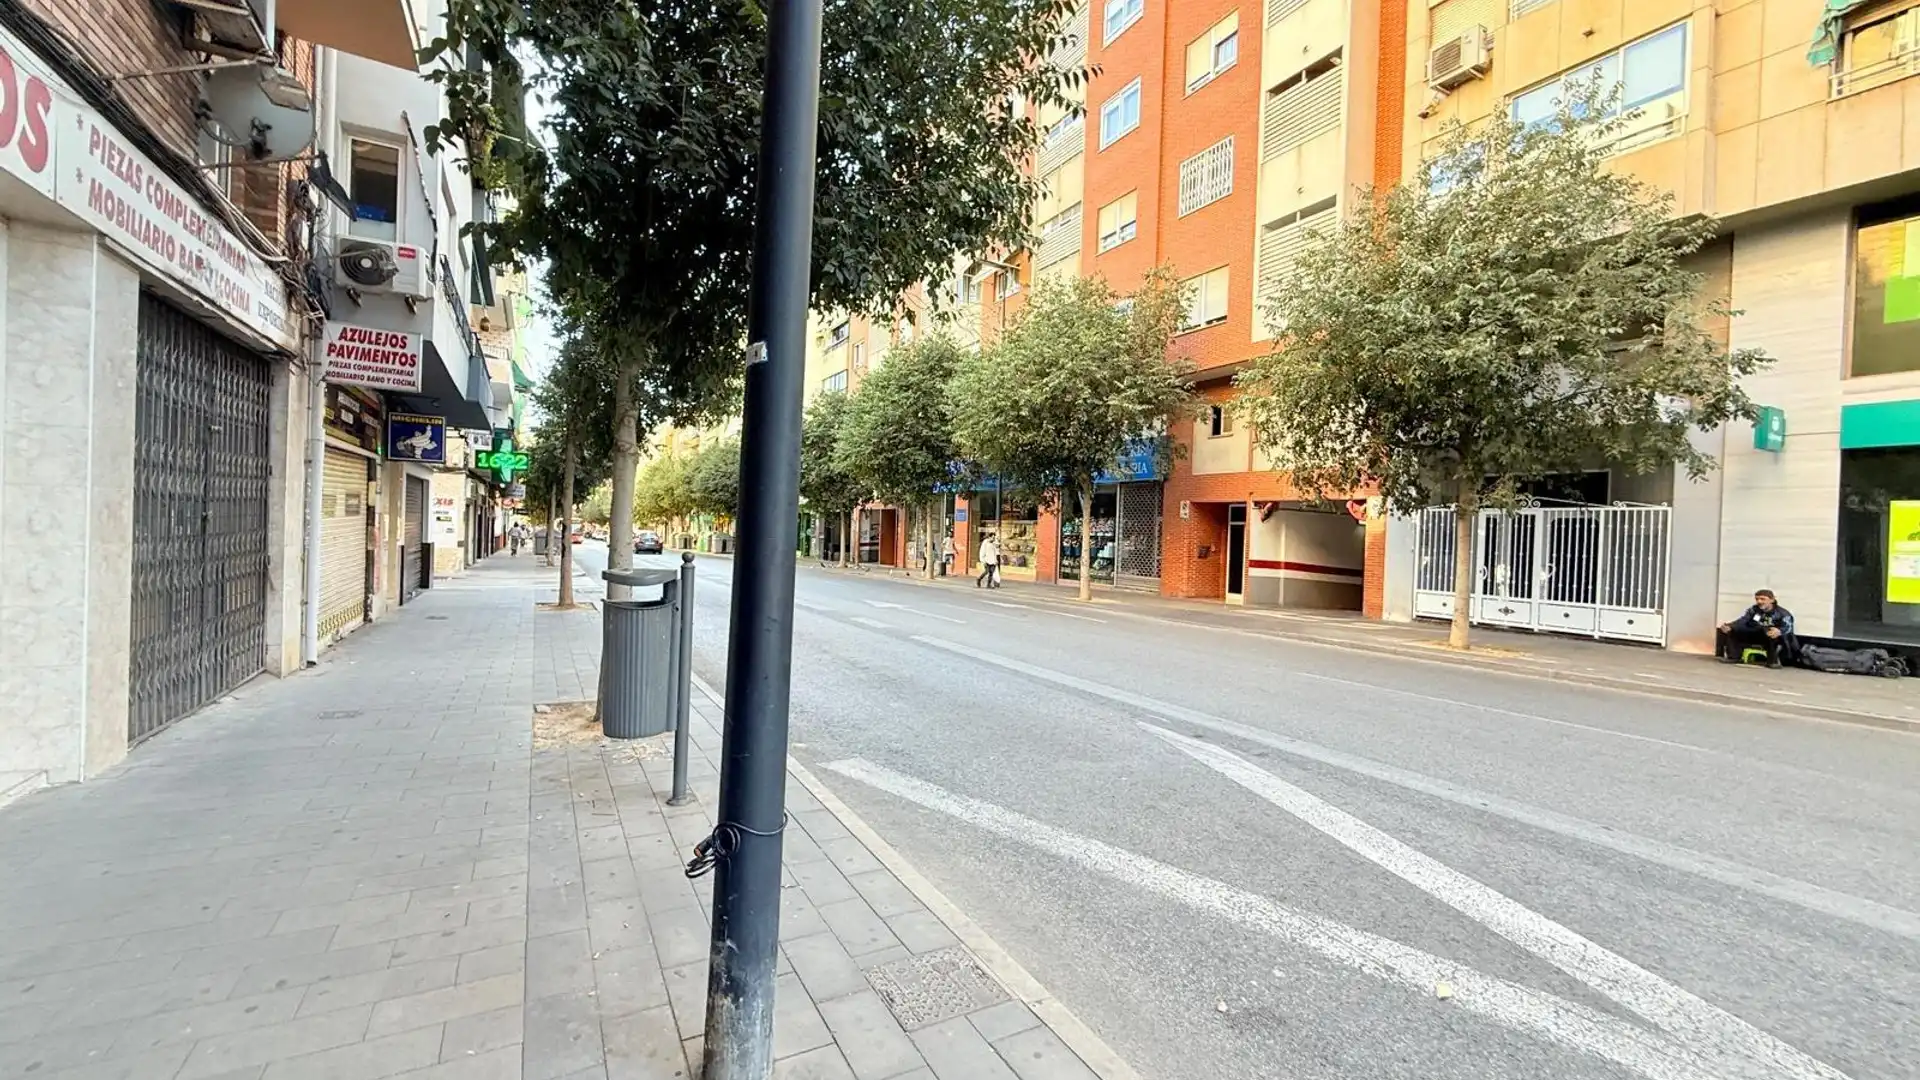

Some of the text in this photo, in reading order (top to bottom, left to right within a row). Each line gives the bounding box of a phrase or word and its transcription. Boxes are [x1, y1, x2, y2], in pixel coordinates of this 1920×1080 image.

[89, 123, 144, 194] PIEZAS
[88, 177, 176, 263] MOBILIARIO
[338, 327, 408, 350] AZULEJOS
[327, 342, 417, 368] PAVIMENTOS
[325, 370, 365, 381] MOBILIARIO
[393, 378, 416, 387] COCINA
[328, 360, 414, 377] PIEZAS COMPLEMENTARIAS
[391, 415, 443, 425] MICHELIN
